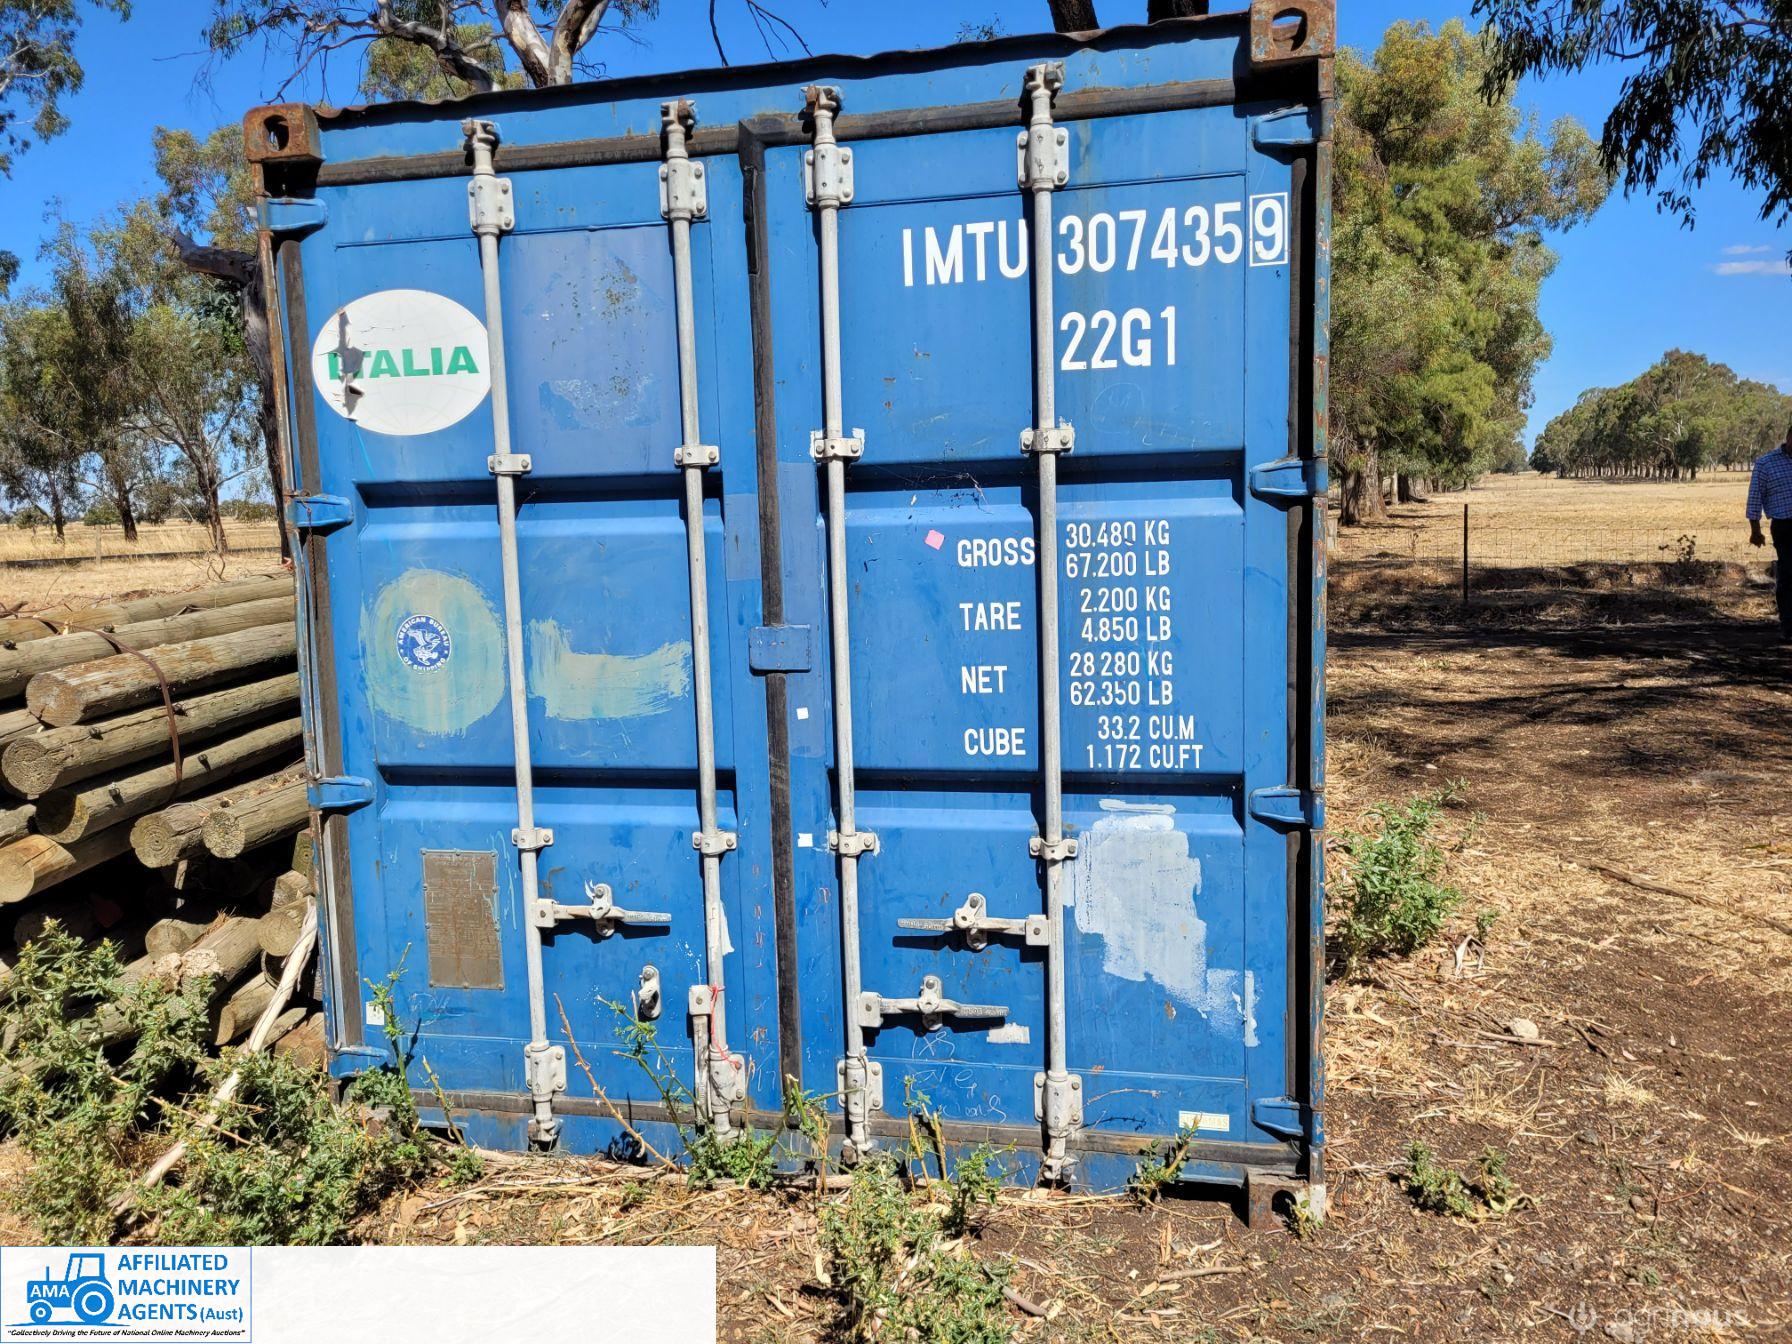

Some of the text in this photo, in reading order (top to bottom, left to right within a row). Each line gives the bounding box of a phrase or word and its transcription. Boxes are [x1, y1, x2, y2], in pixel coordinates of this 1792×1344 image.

[902, 218, 1028, 287] IMTU
[1060, 305, 1177, 371] 22G1
[1065, 519, 1171, 549] 30.480 KG
[957, 536, 1037, 568] GROSS
[1145, 549, 1171, 577] LB
[1080, 585, 1172, 614] 2.200 KG
[959, 601, 1022, 631] TARE
[1081, 615, 1172, 643] 4.850 LB
[398, 616, 450, 646] AMERICAN BUREAU
[1147, 650, 1174, 677] KG
[961, 665, 1008, 694] NET
[1070, 680, 1173, 706] 62.350 LB
[963, 727, 1026, 756] CUBE
[1097, 714, 1142, 740] 33.2
[1085, 744, 1141, 769] 1.172
